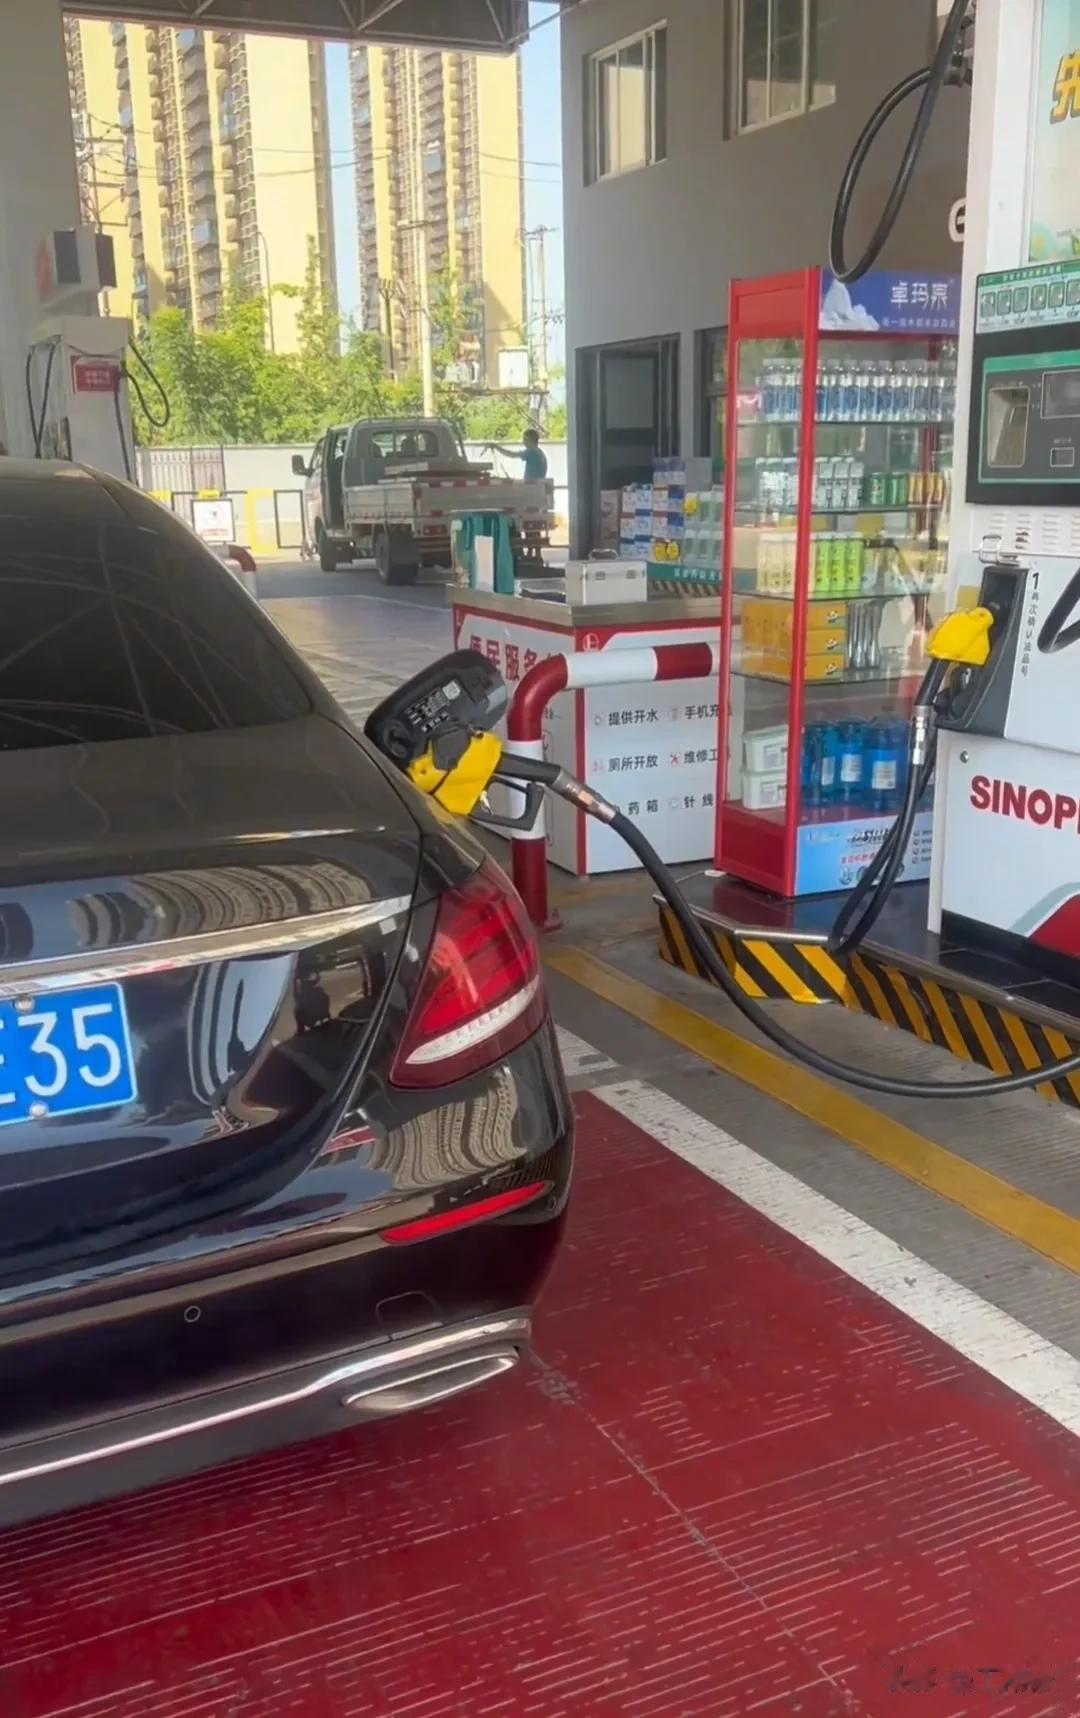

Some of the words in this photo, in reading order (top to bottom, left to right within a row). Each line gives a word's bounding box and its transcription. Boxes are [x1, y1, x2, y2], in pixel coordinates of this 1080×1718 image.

[1032, 572, 1040, 590] 1
[608, 708, 659, 727] 提供开水
[607, 755, 659, 773] 厕所开放
[684, 748, 731, 764] 维修工
[970, 775, 1080, 834] SINOP
